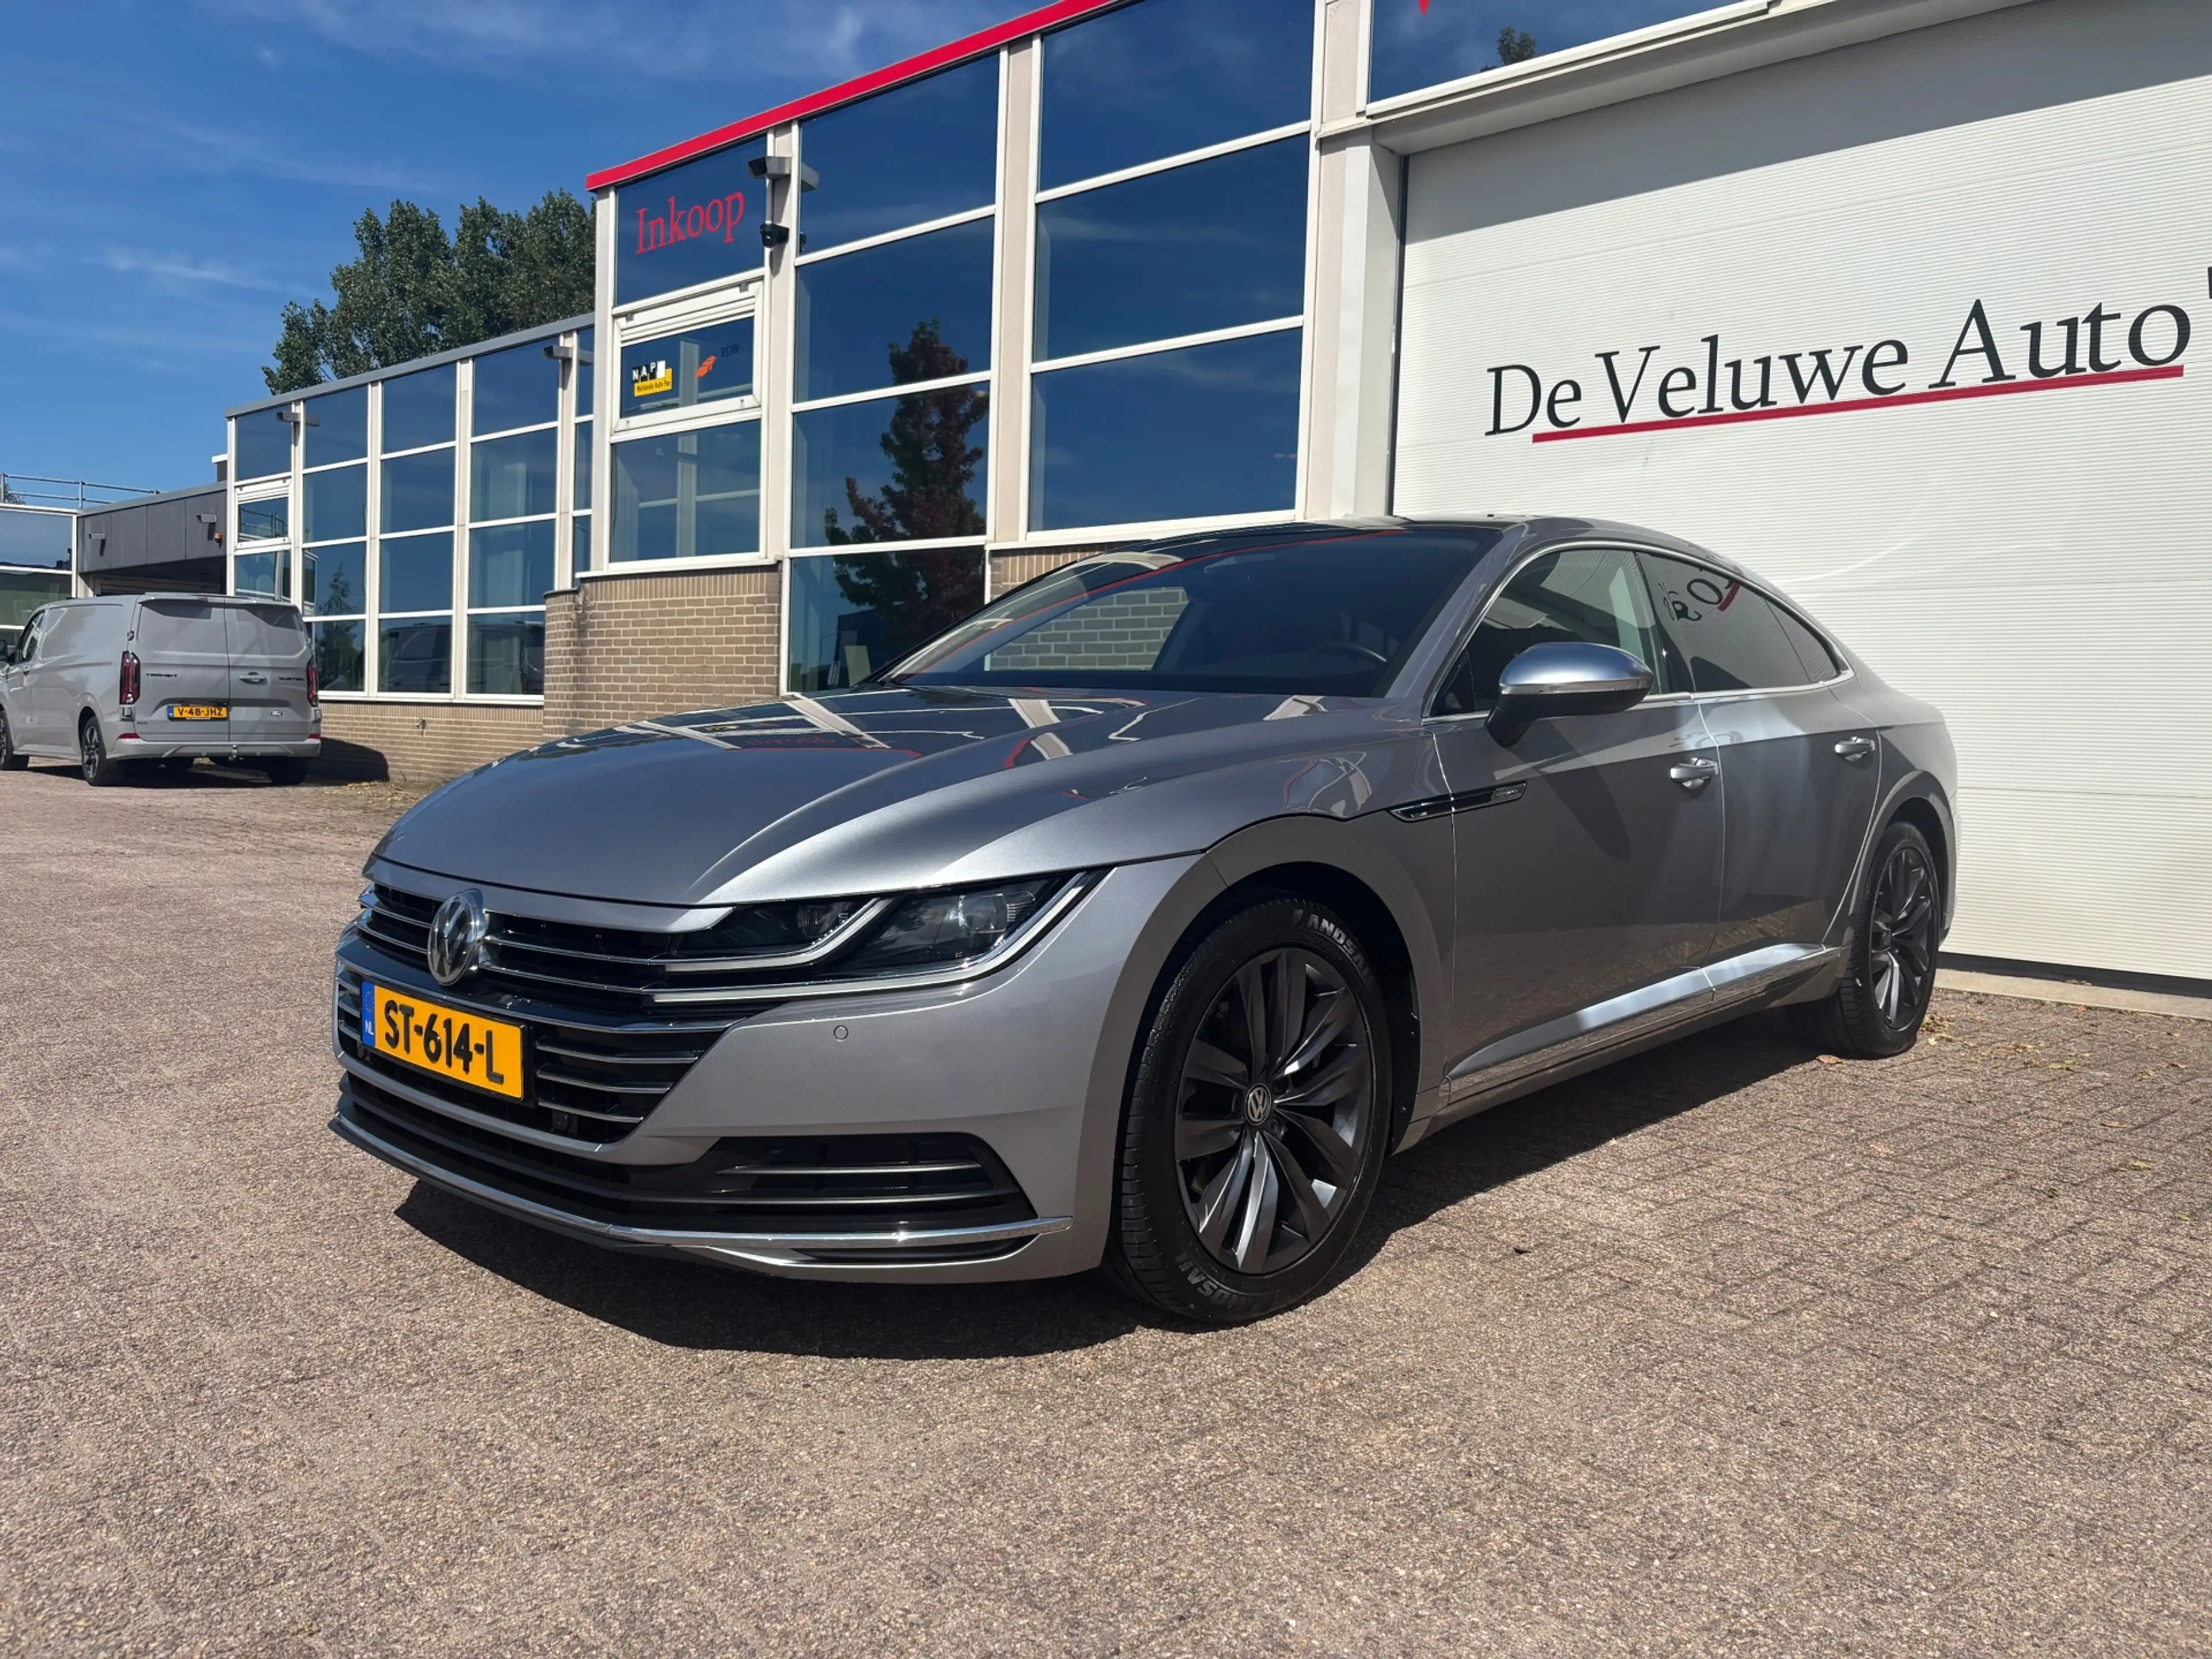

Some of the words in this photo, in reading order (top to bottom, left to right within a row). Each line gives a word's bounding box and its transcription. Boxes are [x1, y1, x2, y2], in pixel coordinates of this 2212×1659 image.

[635, 192, 744, 254] Inkoop
[632, 361, 656, 381] NAP
[1485, 365, 1581, 436] De
[1594, 334, 1908, 423] Veluwe
[177, 707, 224, 717] V-48-JHZ
[365, 1019, 374, 1036] NL
[384, 999, 504, 1085] ST-614-L
